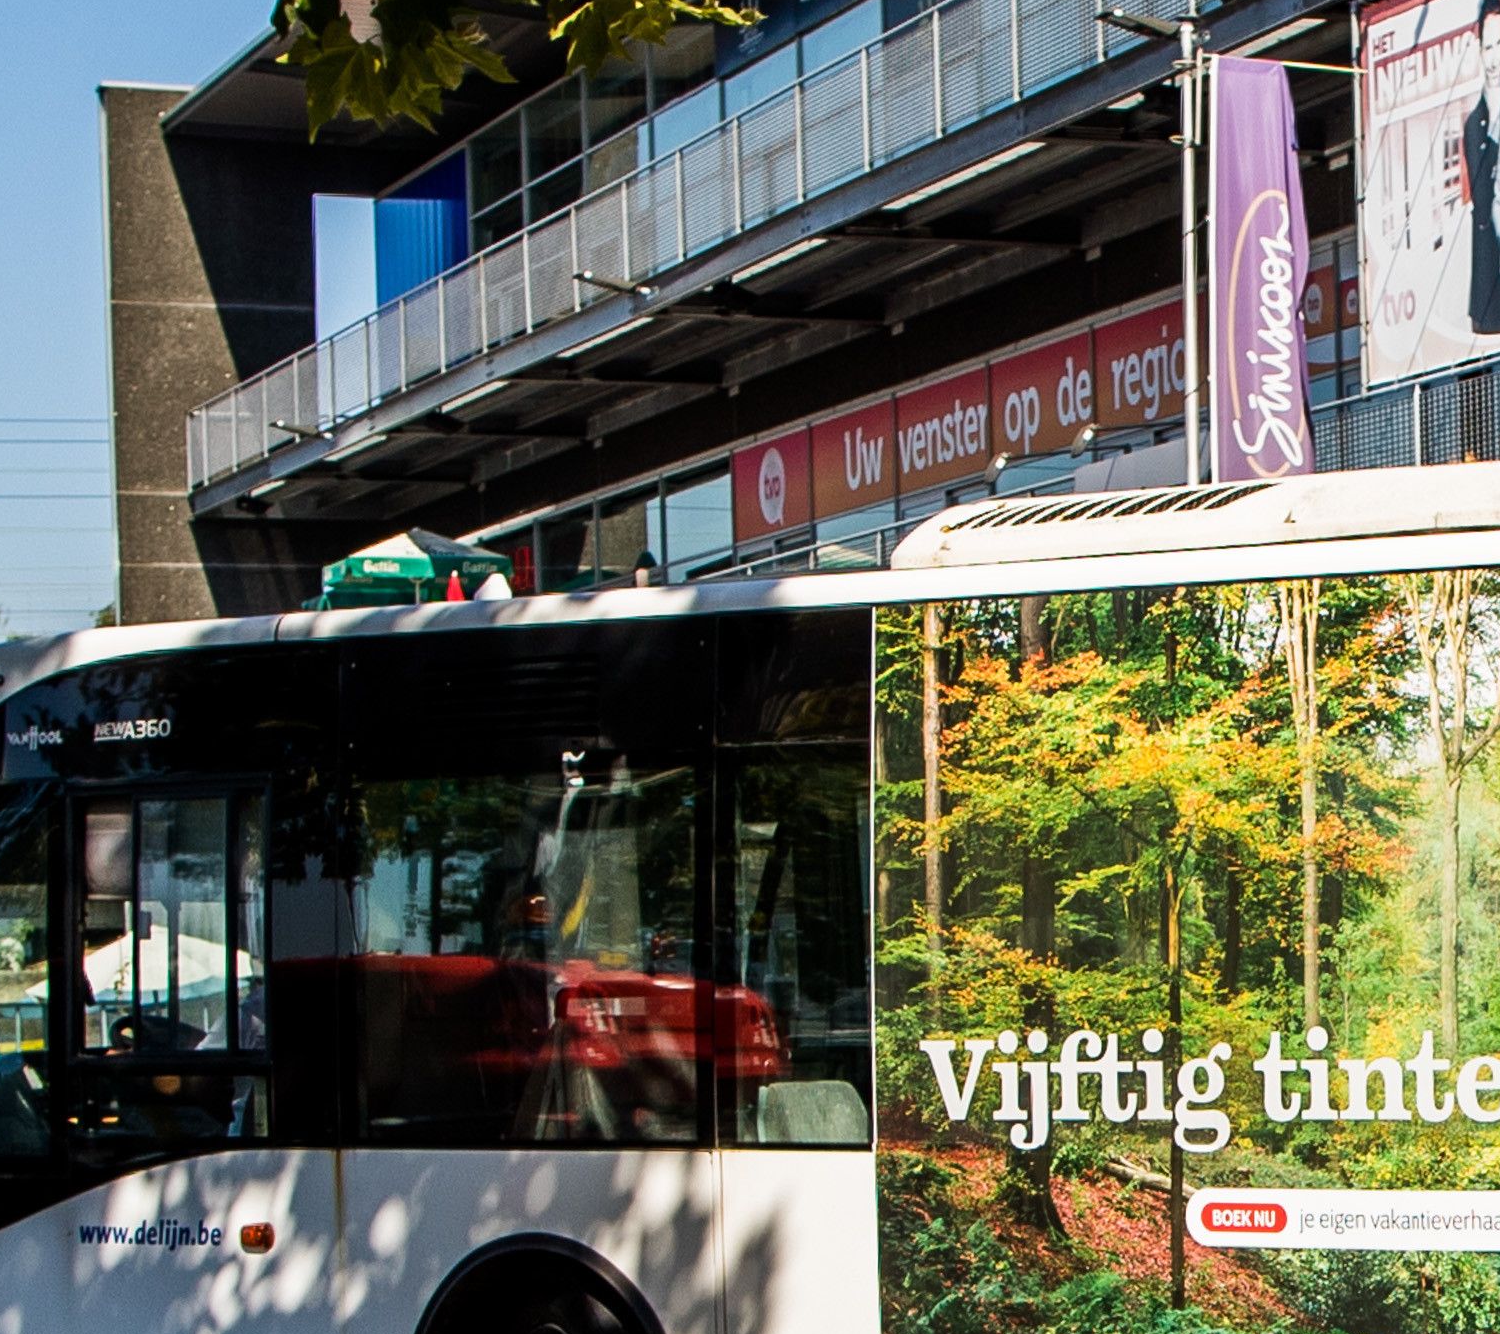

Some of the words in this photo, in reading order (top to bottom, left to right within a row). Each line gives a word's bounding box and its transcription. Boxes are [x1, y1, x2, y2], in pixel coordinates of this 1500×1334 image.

[1372, 30, 1395, 57] HET
[844, 427, 884, 490] Uw
[898, 399, 988, 474] venster
[1005, 386, 1040, 454] op
[1056, 357, 1092, 426] de
[920, 1028, 1232, 1152] Vijftig
[80, 1219, 221, 1251] www.delijn.be
[1212, 1209, 1253, 1227] BOEK
[1254, 1210, 1276, 1228] NU
[1299, 1210, 1314, 1234] je
[1319, 1210, 1366, 1235] eigen
